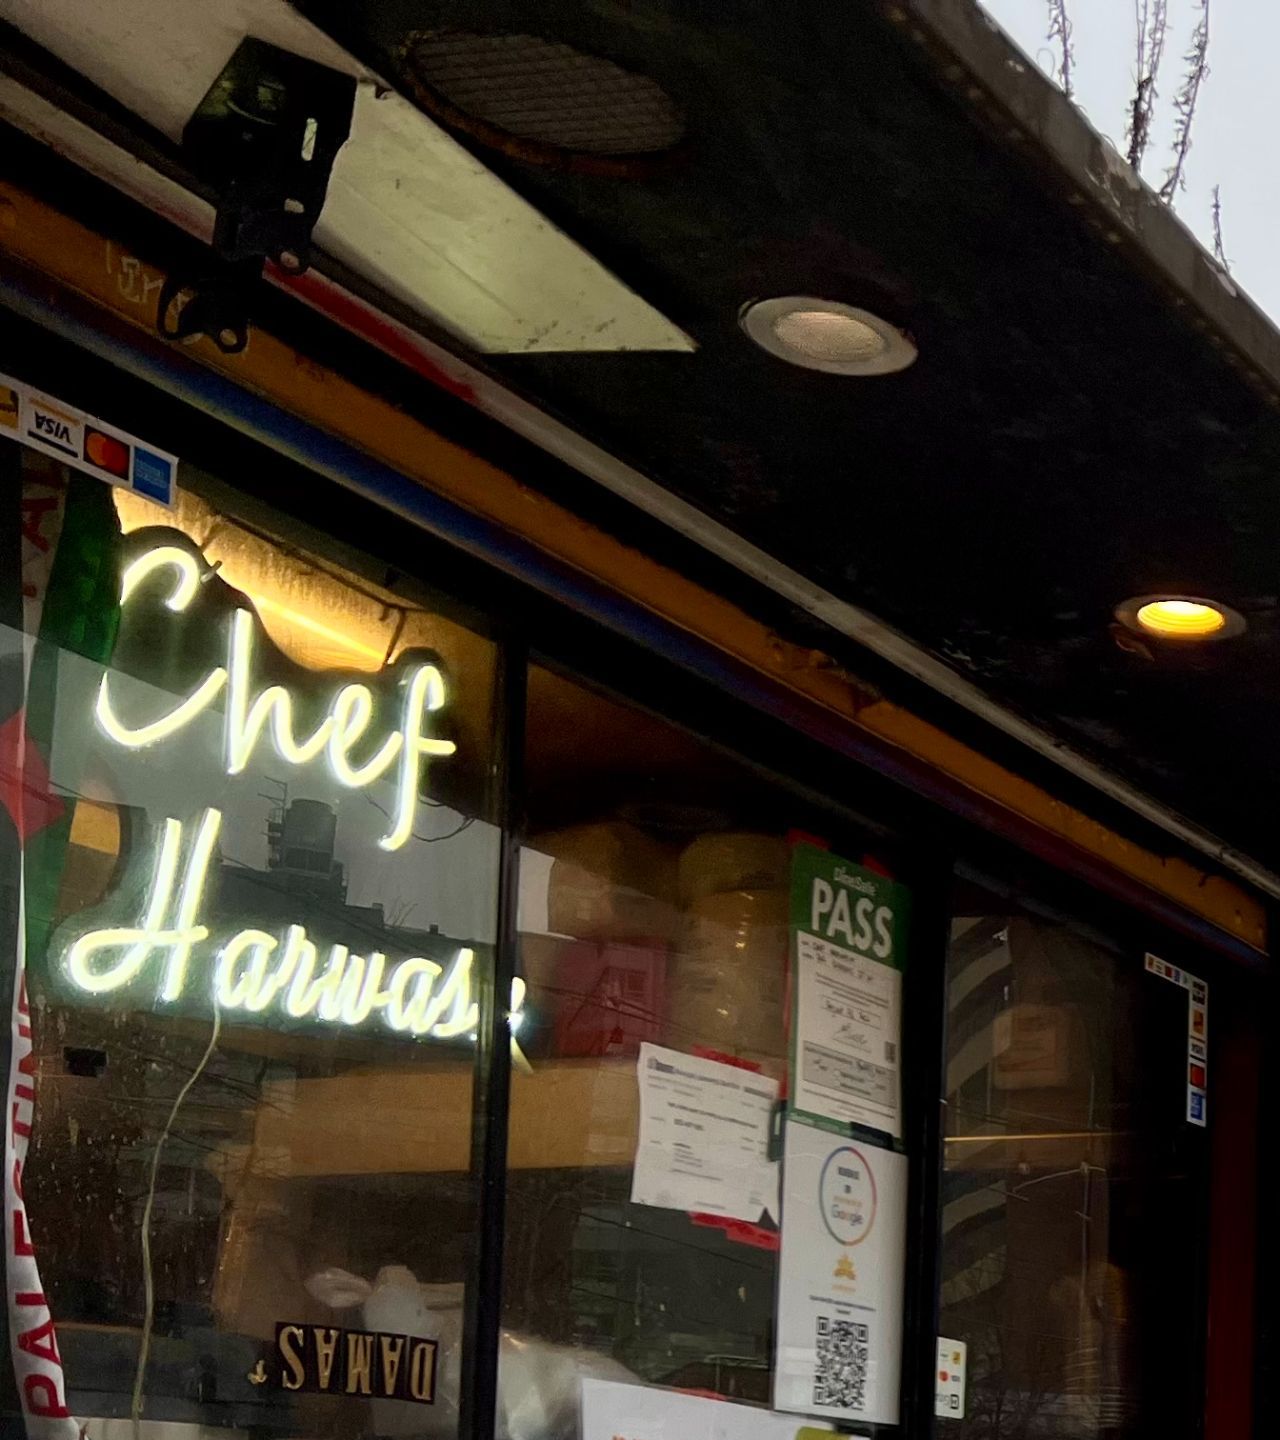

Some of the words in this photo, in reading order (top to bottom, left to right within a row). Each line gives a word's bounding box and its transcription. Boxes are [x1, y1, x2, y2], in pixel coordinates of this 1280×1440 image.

[34, 411, 73, 445] VISA
[97, 545, 456, 852] Chef
[68, 807, 526, 1038] Harwas
[812, 877, 893, 958] PASS
